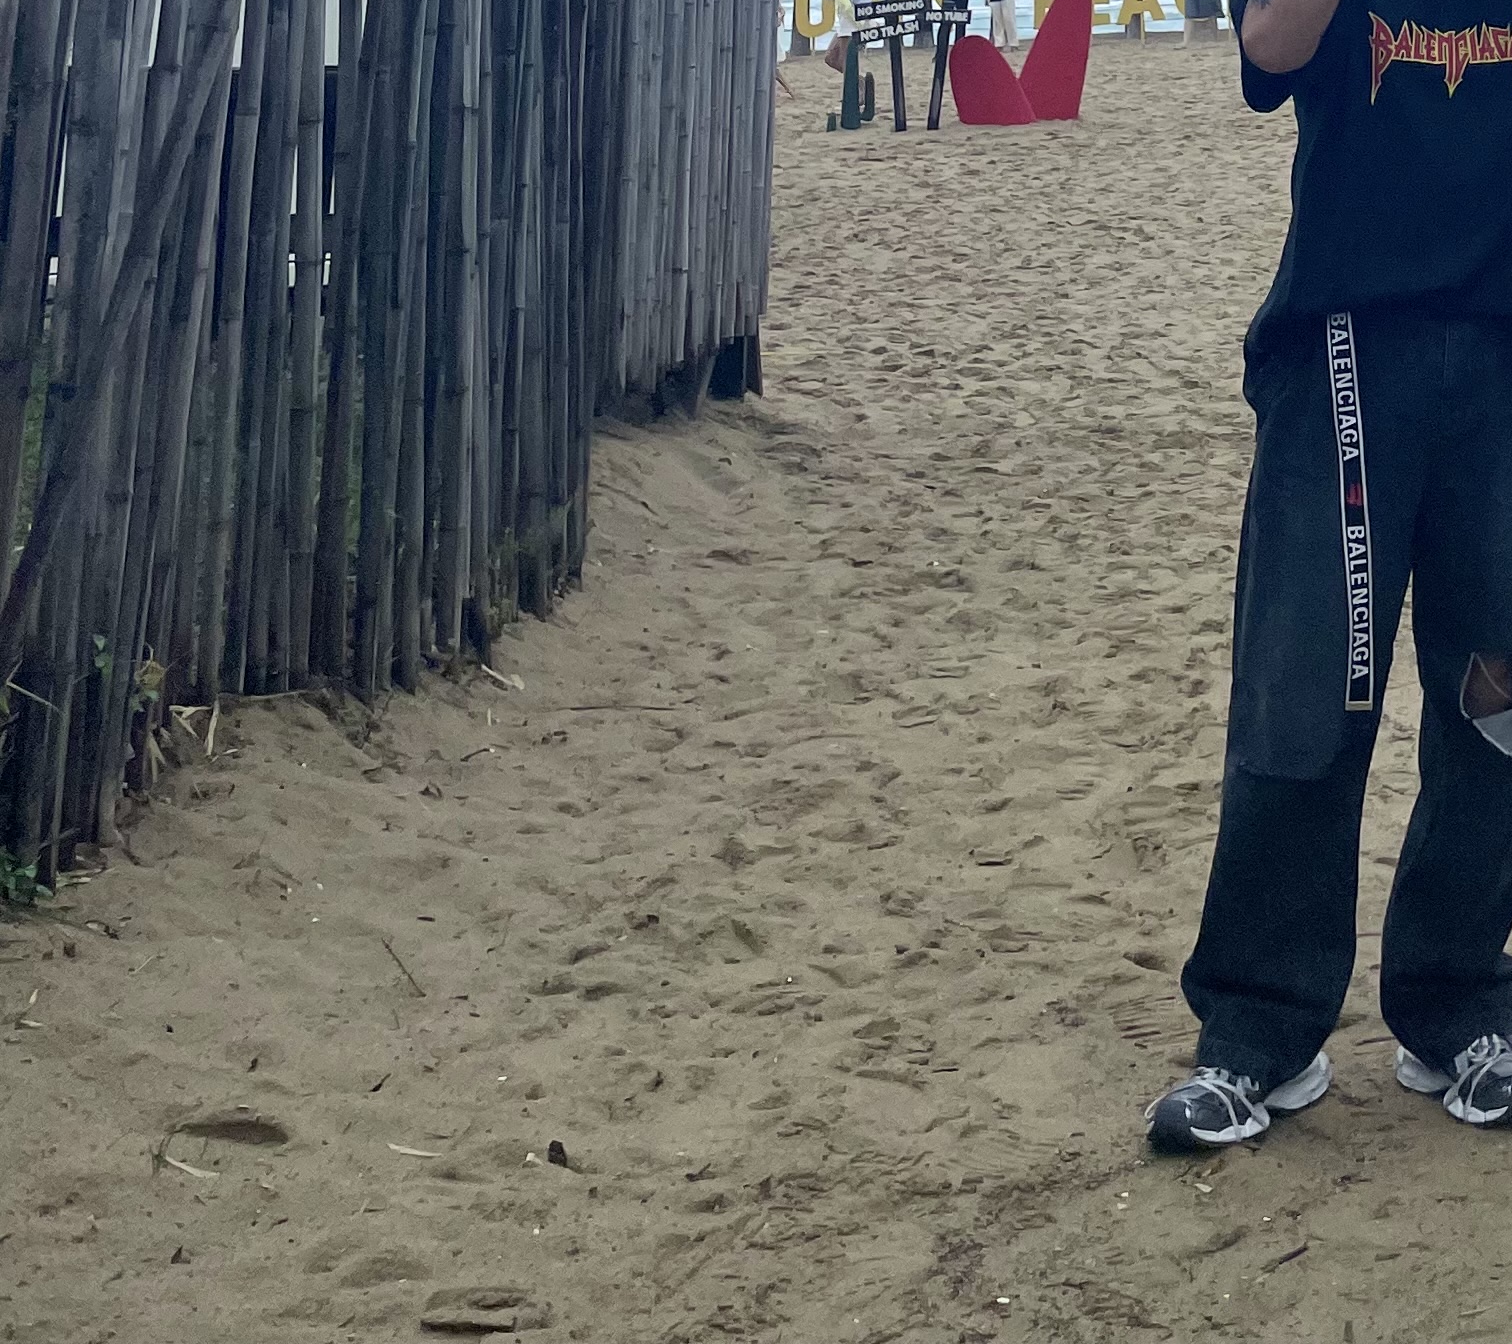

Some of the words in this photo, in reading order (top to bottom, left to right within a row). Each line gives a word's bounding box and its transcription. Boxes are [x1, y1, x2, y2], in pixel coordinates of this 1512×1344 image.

[857, 5, 873, 17] NO
[875, 0, 924, 15] SMOKING
[925, 11, 942, 21] NO
[944, 11, 968, 22] TUBE
[860, 29, 879, 42] NO
[881, 21, 919, 38] TRASH
[1330, 312, 1360, 462] BALENCIAGA
[1346, 525, 1370, 681] BALENCIAGA
